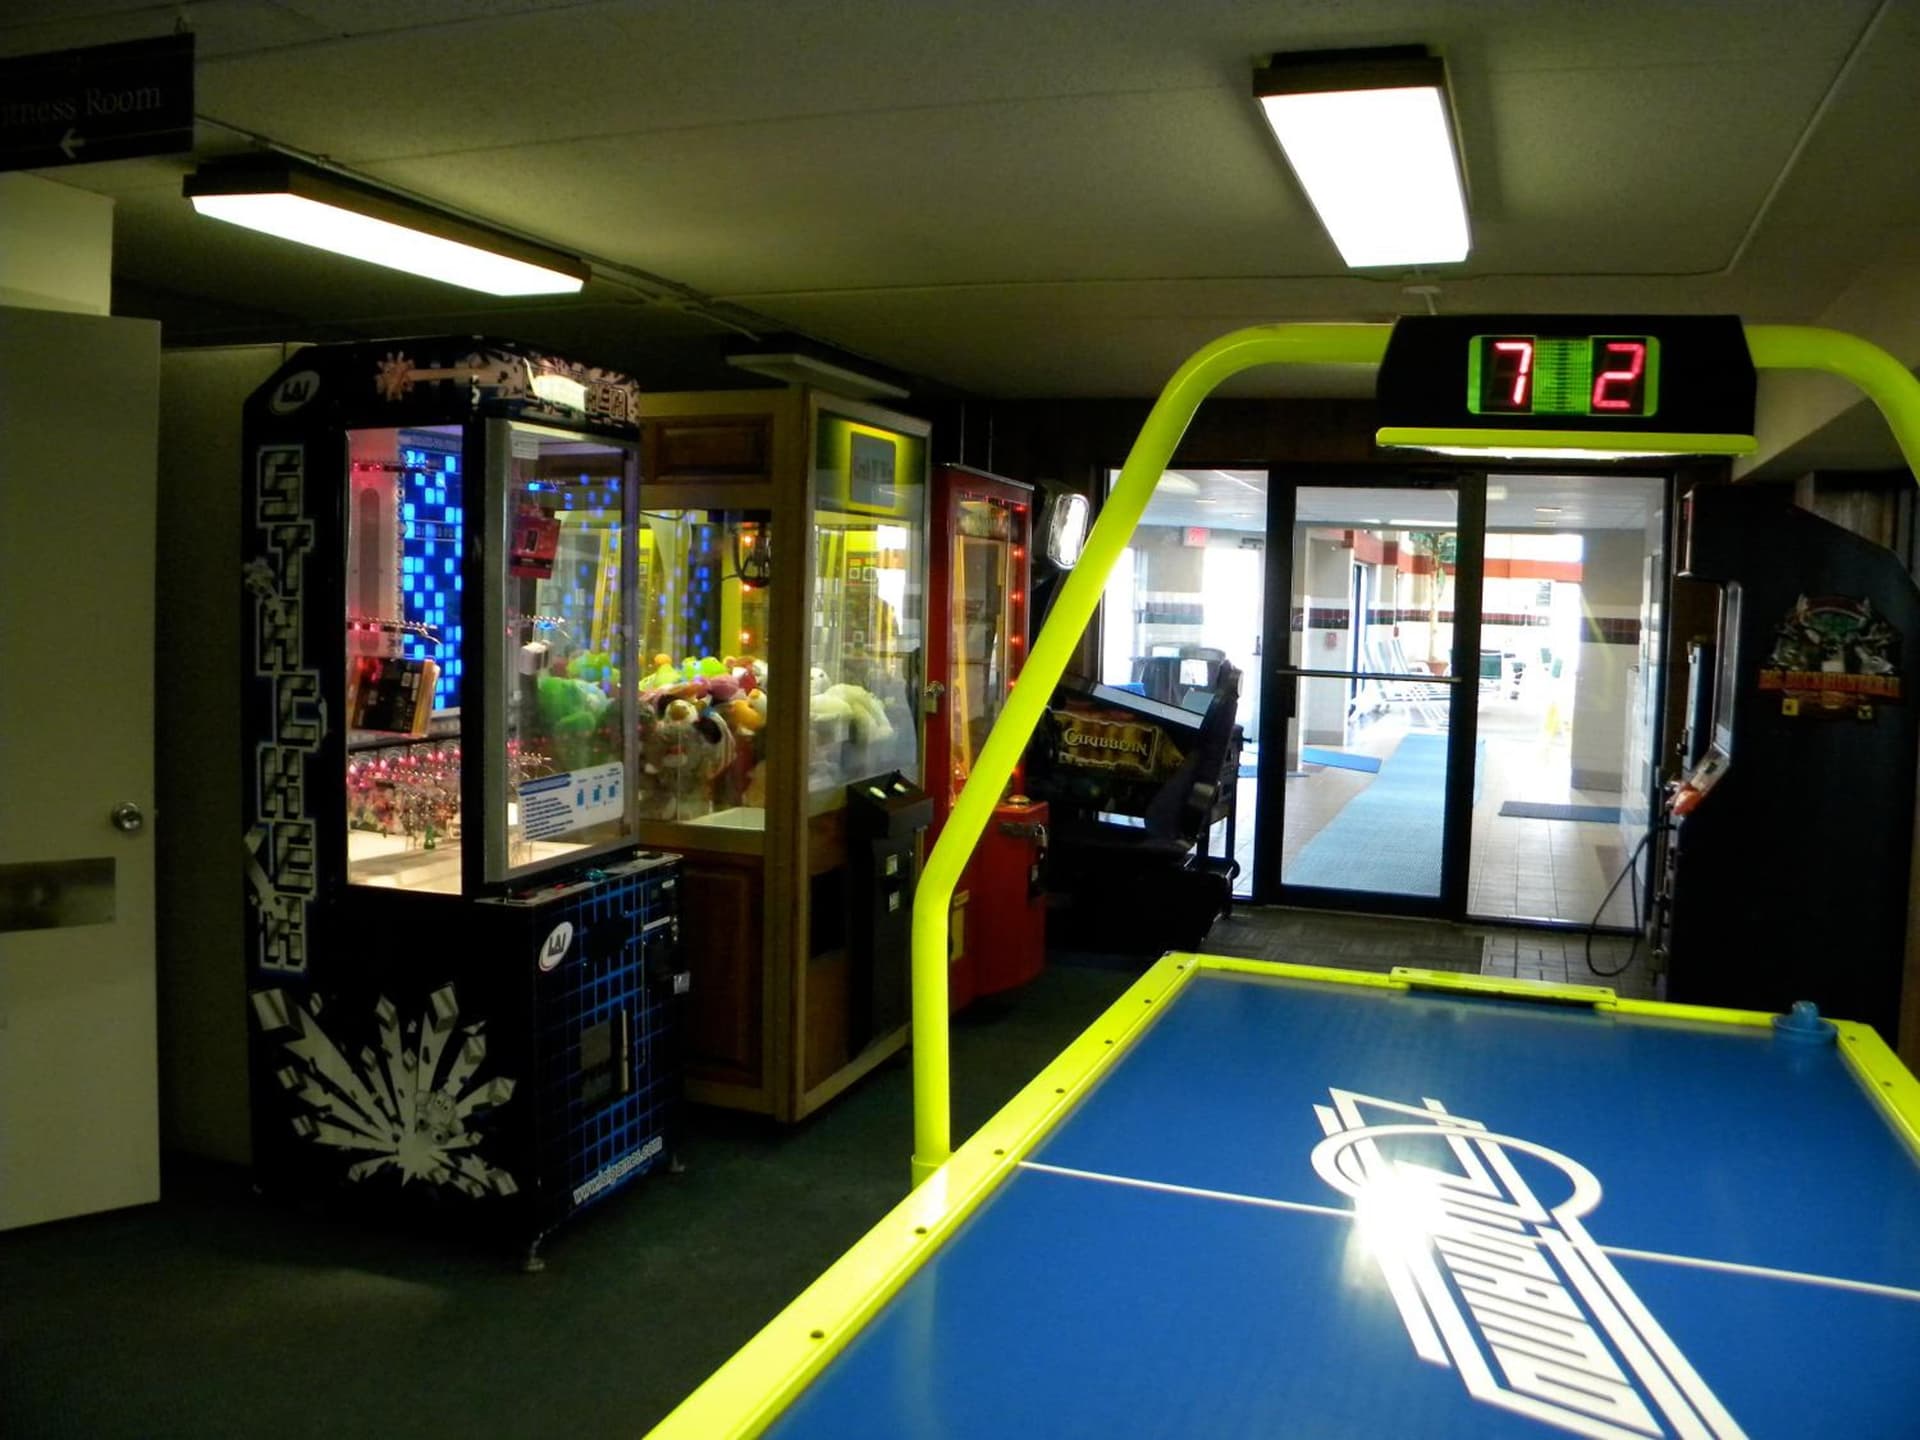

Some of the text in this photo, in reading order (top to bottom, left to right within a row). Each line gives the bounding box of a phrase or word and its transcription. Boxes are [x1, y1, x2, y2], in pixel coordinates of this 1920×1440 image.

[83, 83, 165, 118] Room
[1494, 342, 1645, 408] 7 2
[255, 442, 322, 976] STACKER
[1063, 727, 1149, 758] CARIBBEAN
